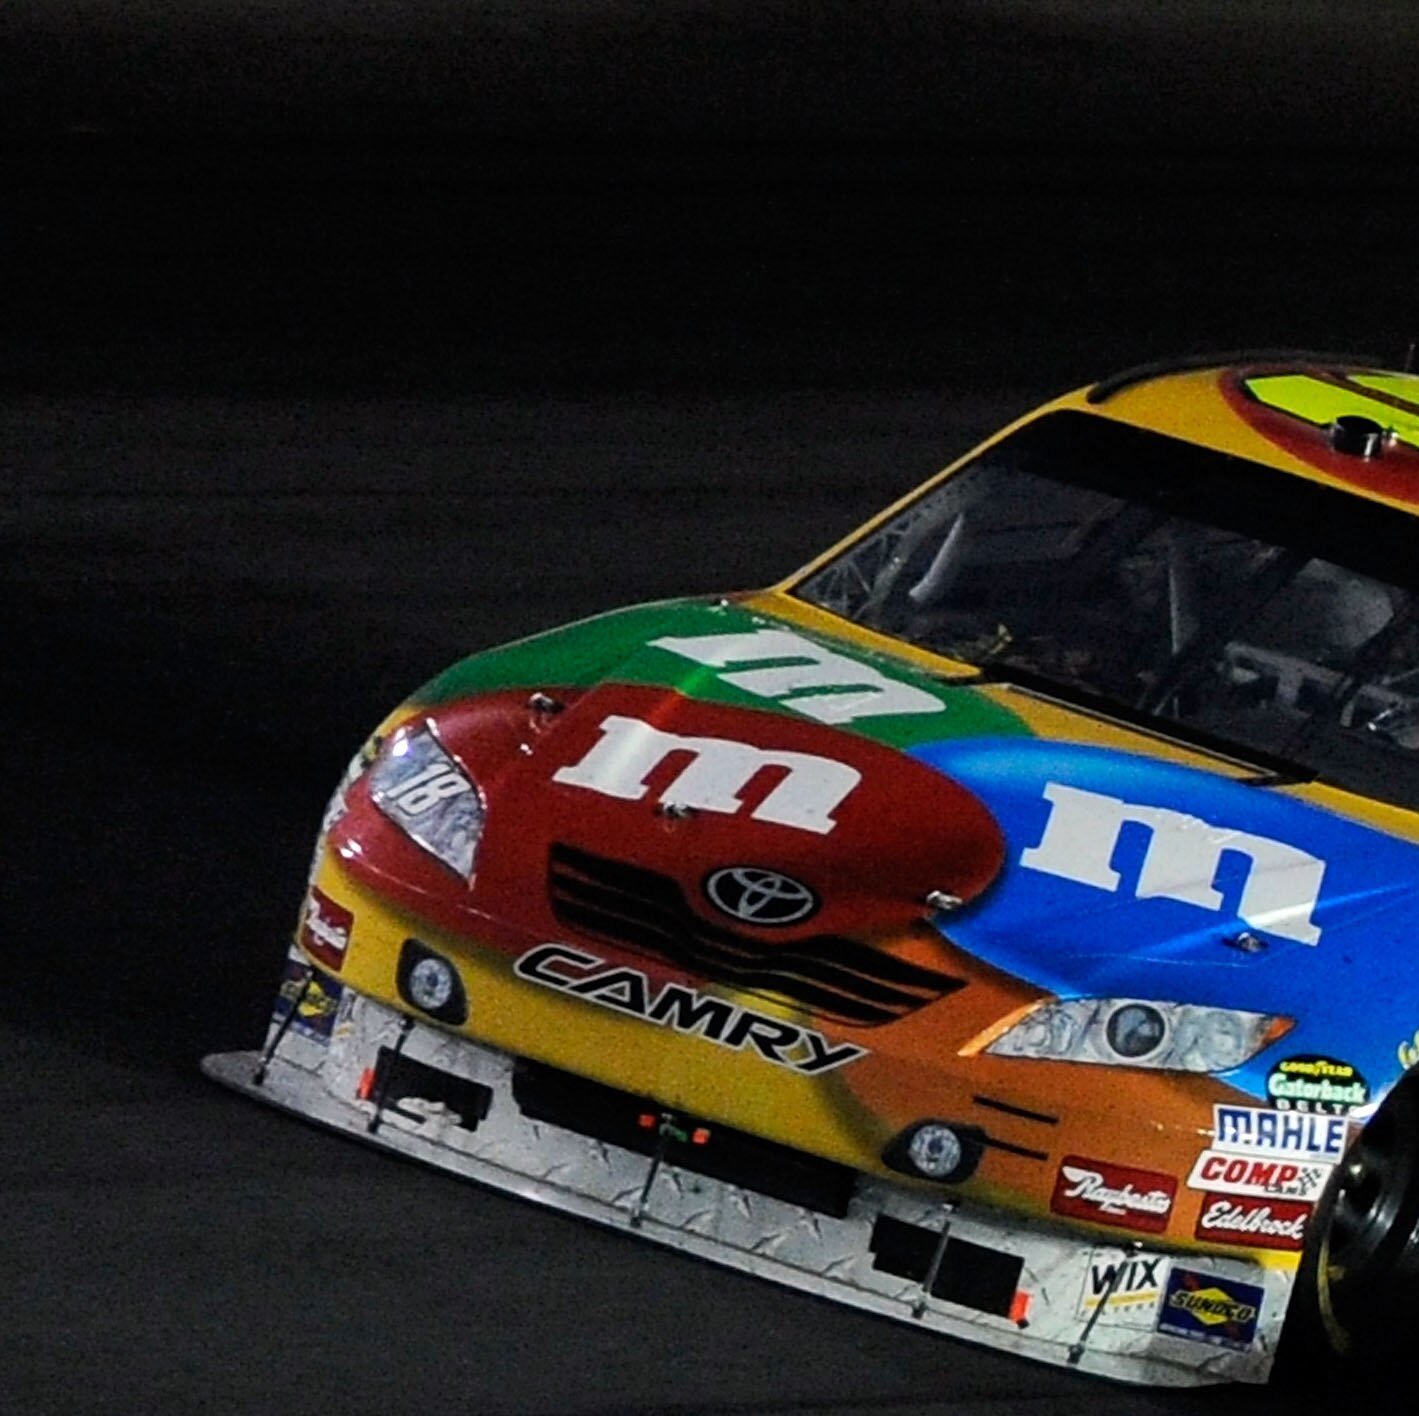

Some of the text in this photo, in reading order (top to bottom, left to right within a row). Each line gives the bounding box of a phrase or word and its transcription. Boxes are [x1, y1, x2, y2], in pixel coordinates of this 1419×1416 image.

[648, 629, 946, 725] m
[385, 762, 472, 815] 18
[552, 715, 862, 835] m
[1020, 781, 1326, 946] m
[515, 945, 866, 1073] CAMRY
[1268, 1072, 1367, 1104] Gatorback
[1218, 1108, 1344, 1153] MAHLE
[1200, 1156, 1299, 1187] COMP
[1201, 1200, 1308, 1240] Edelbrock
[1091, 1256, 1161, 1296] WIX
[1169, 1289, 1256, 1323] SUNOCO
